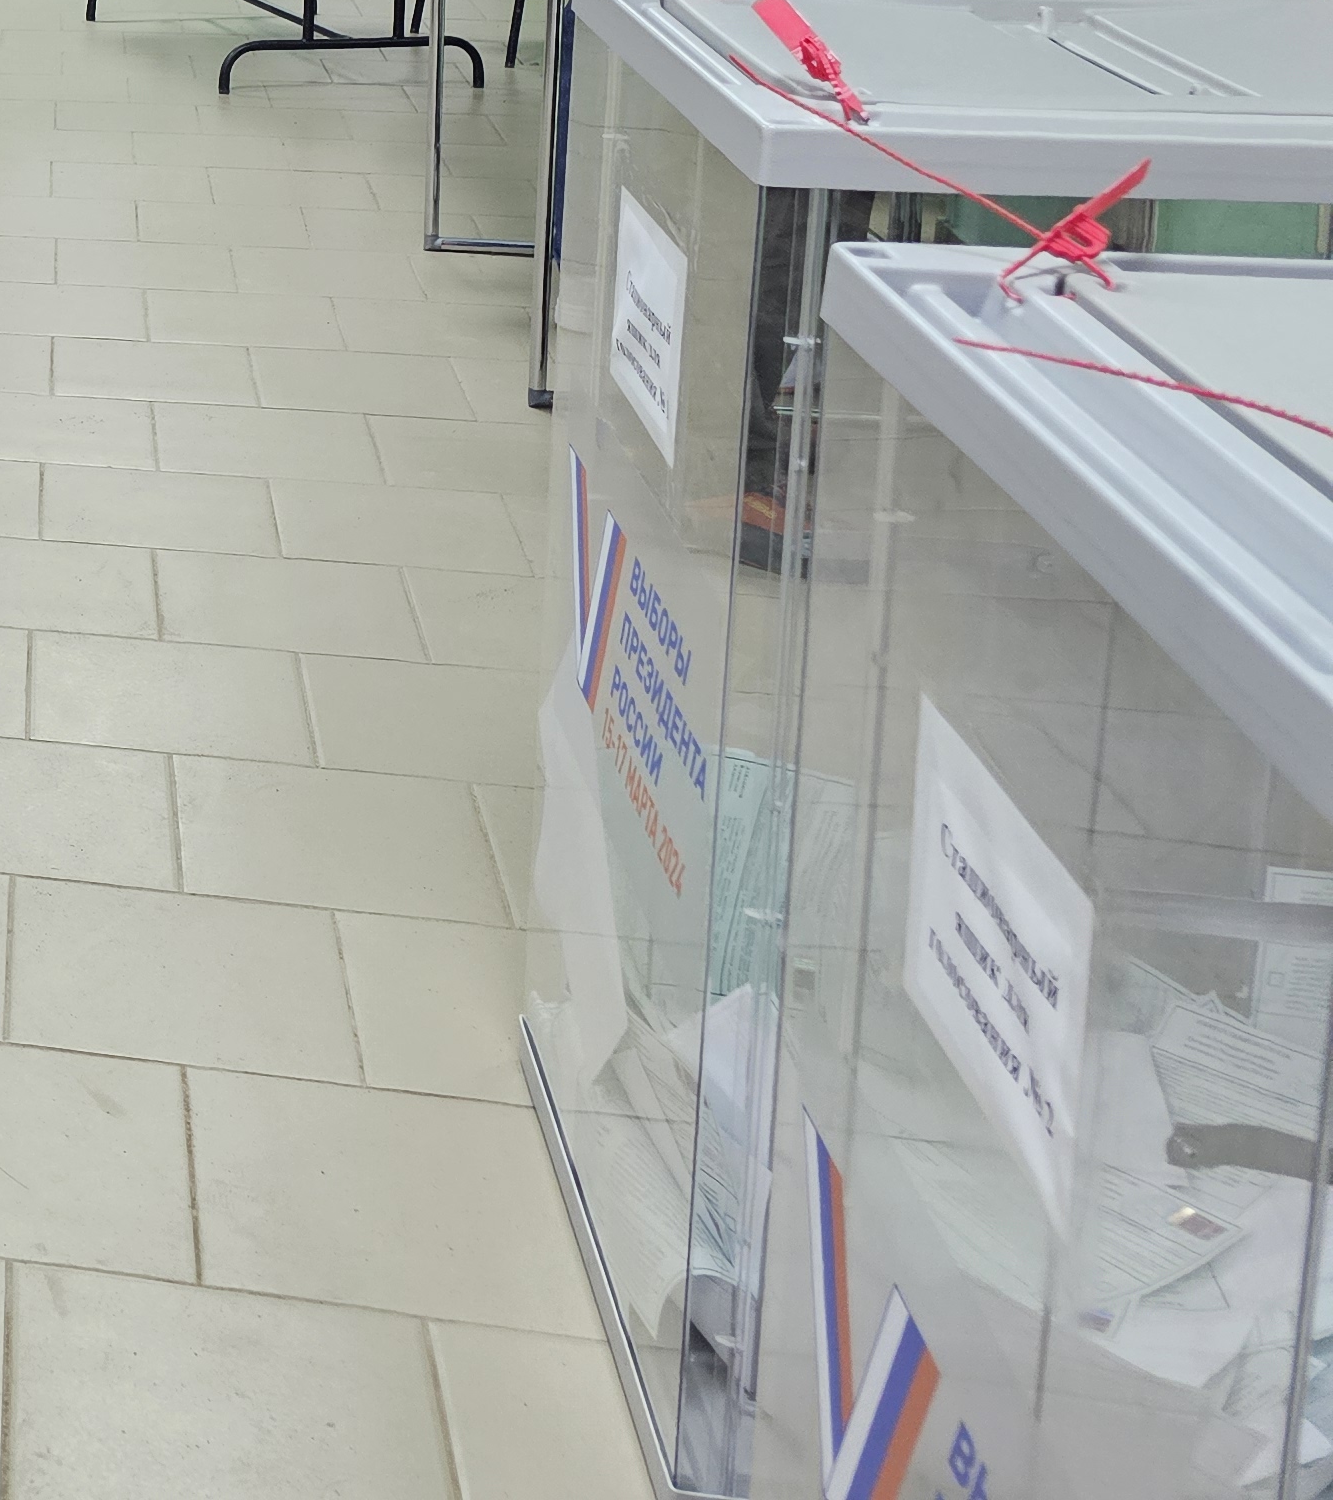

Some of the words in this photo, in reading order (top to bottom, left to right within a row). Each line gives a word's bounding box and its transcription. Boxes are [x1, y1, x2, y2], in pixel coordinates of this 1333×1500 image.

[629, 556, 693, 687] ВЫБОРЫ
[610, 663, 664, 788] РОССИИ
[619, 610, 708, 803] ПРЕЗИДЕНТА
[601, 706, 628, 776] 15-17
[625, 763, 660, 850] МАРТА
[656, 823, 686, 900] 2024
